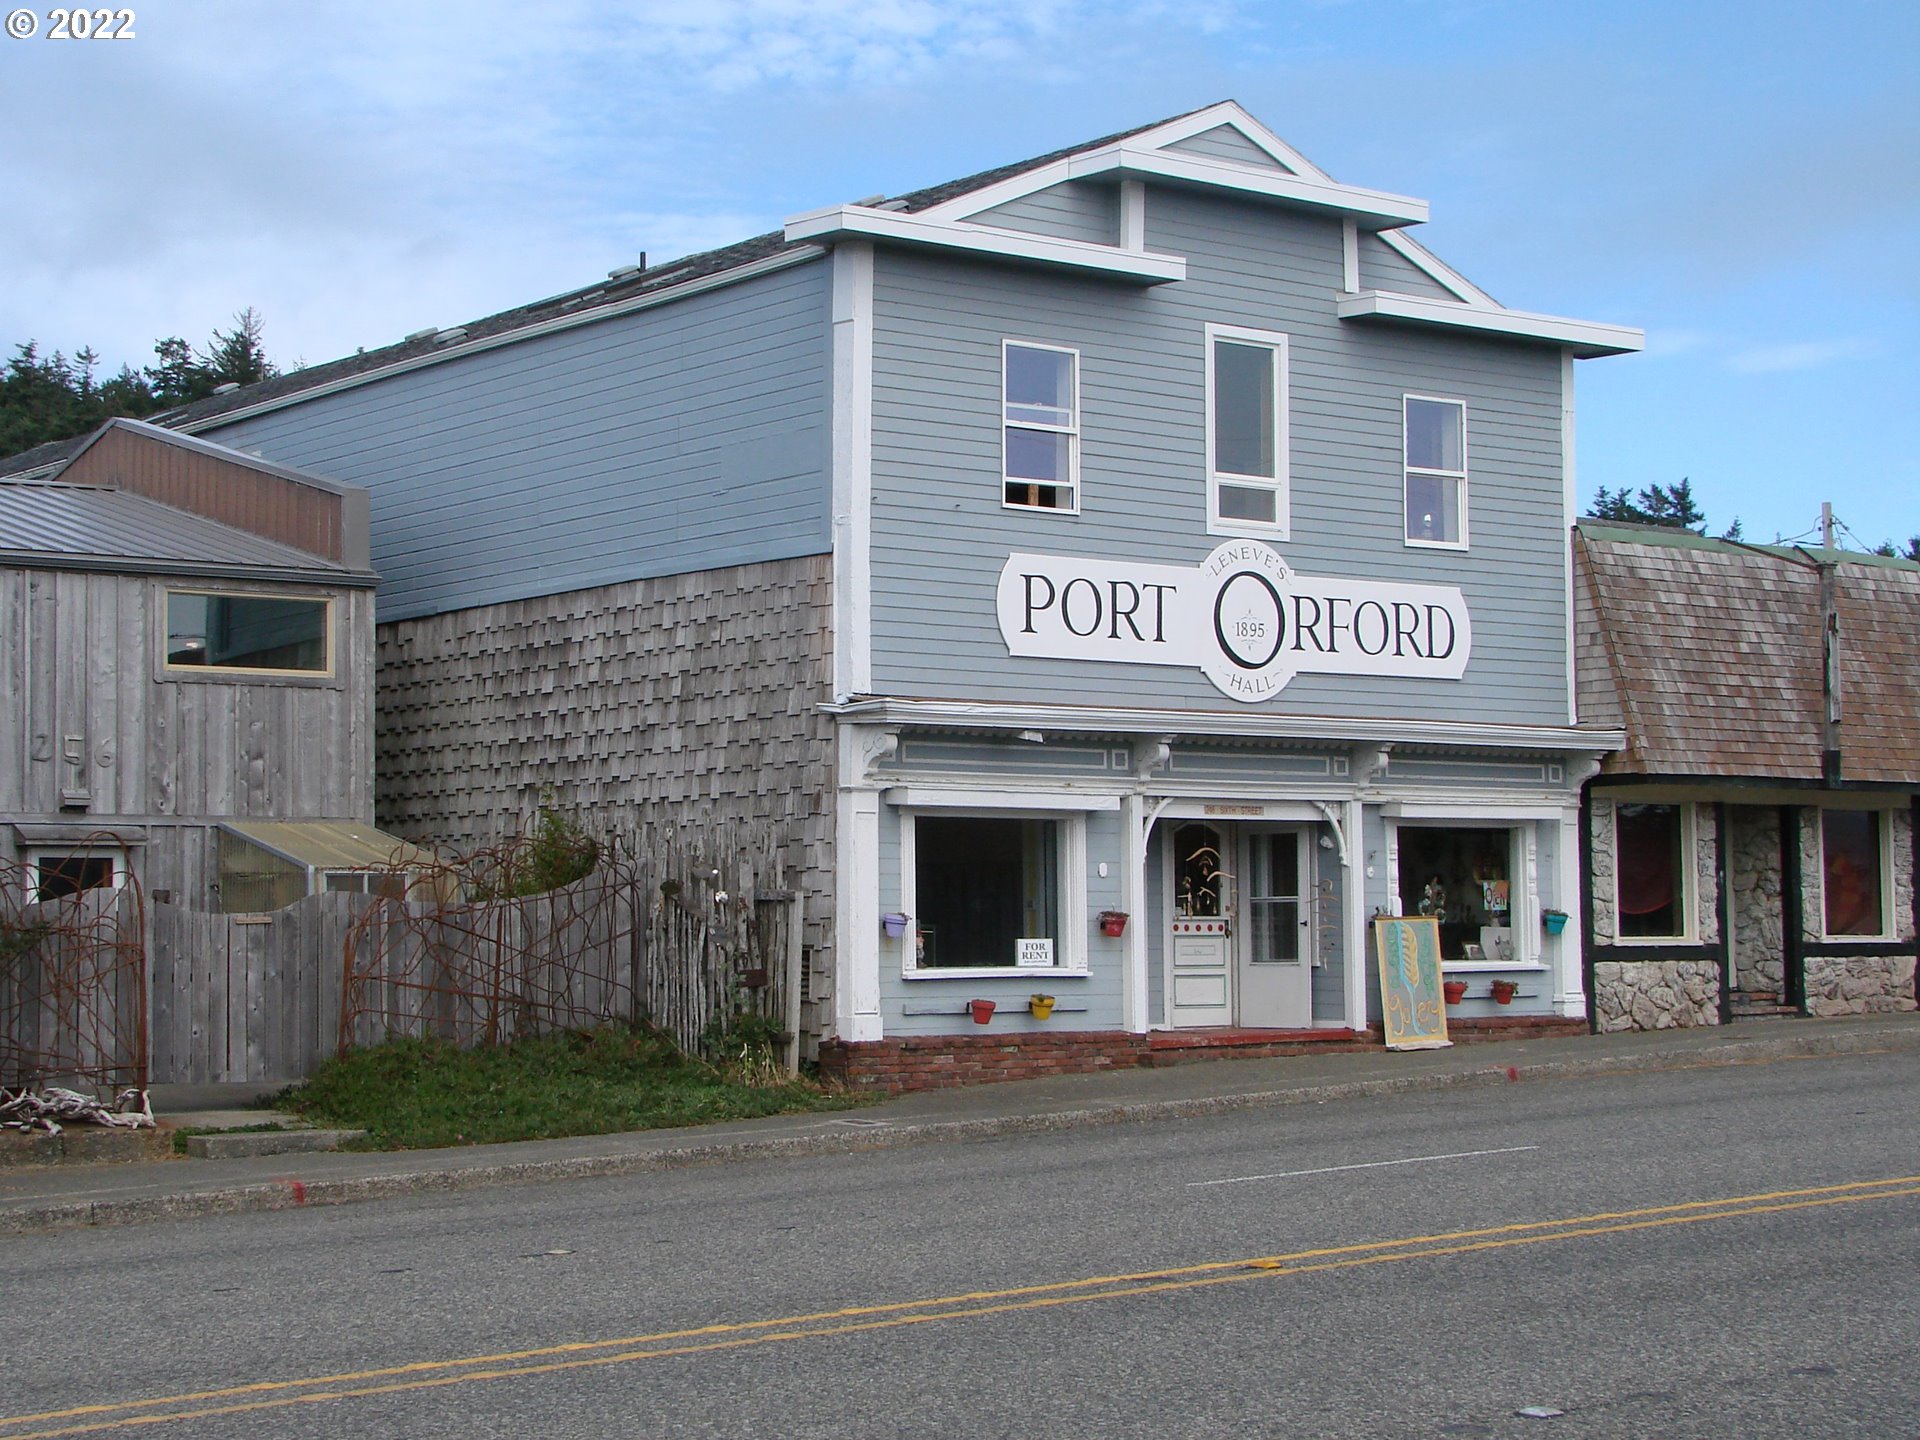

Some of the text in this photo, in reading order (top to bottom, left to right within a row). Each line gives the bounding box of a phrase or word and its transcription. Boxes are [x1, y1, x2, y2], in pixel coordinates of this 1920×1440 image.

[1210, 546, 1288, 580] LENEVE'S
[1019, 570, 1456, 670] PORT ORFORD
[1235, 621, 1265, 638] 1895
[1230, 673, 1276, 694] HALL
[1022, 951, 1048, 960] RENT
[1025, 942, 1046, 951] FOR
